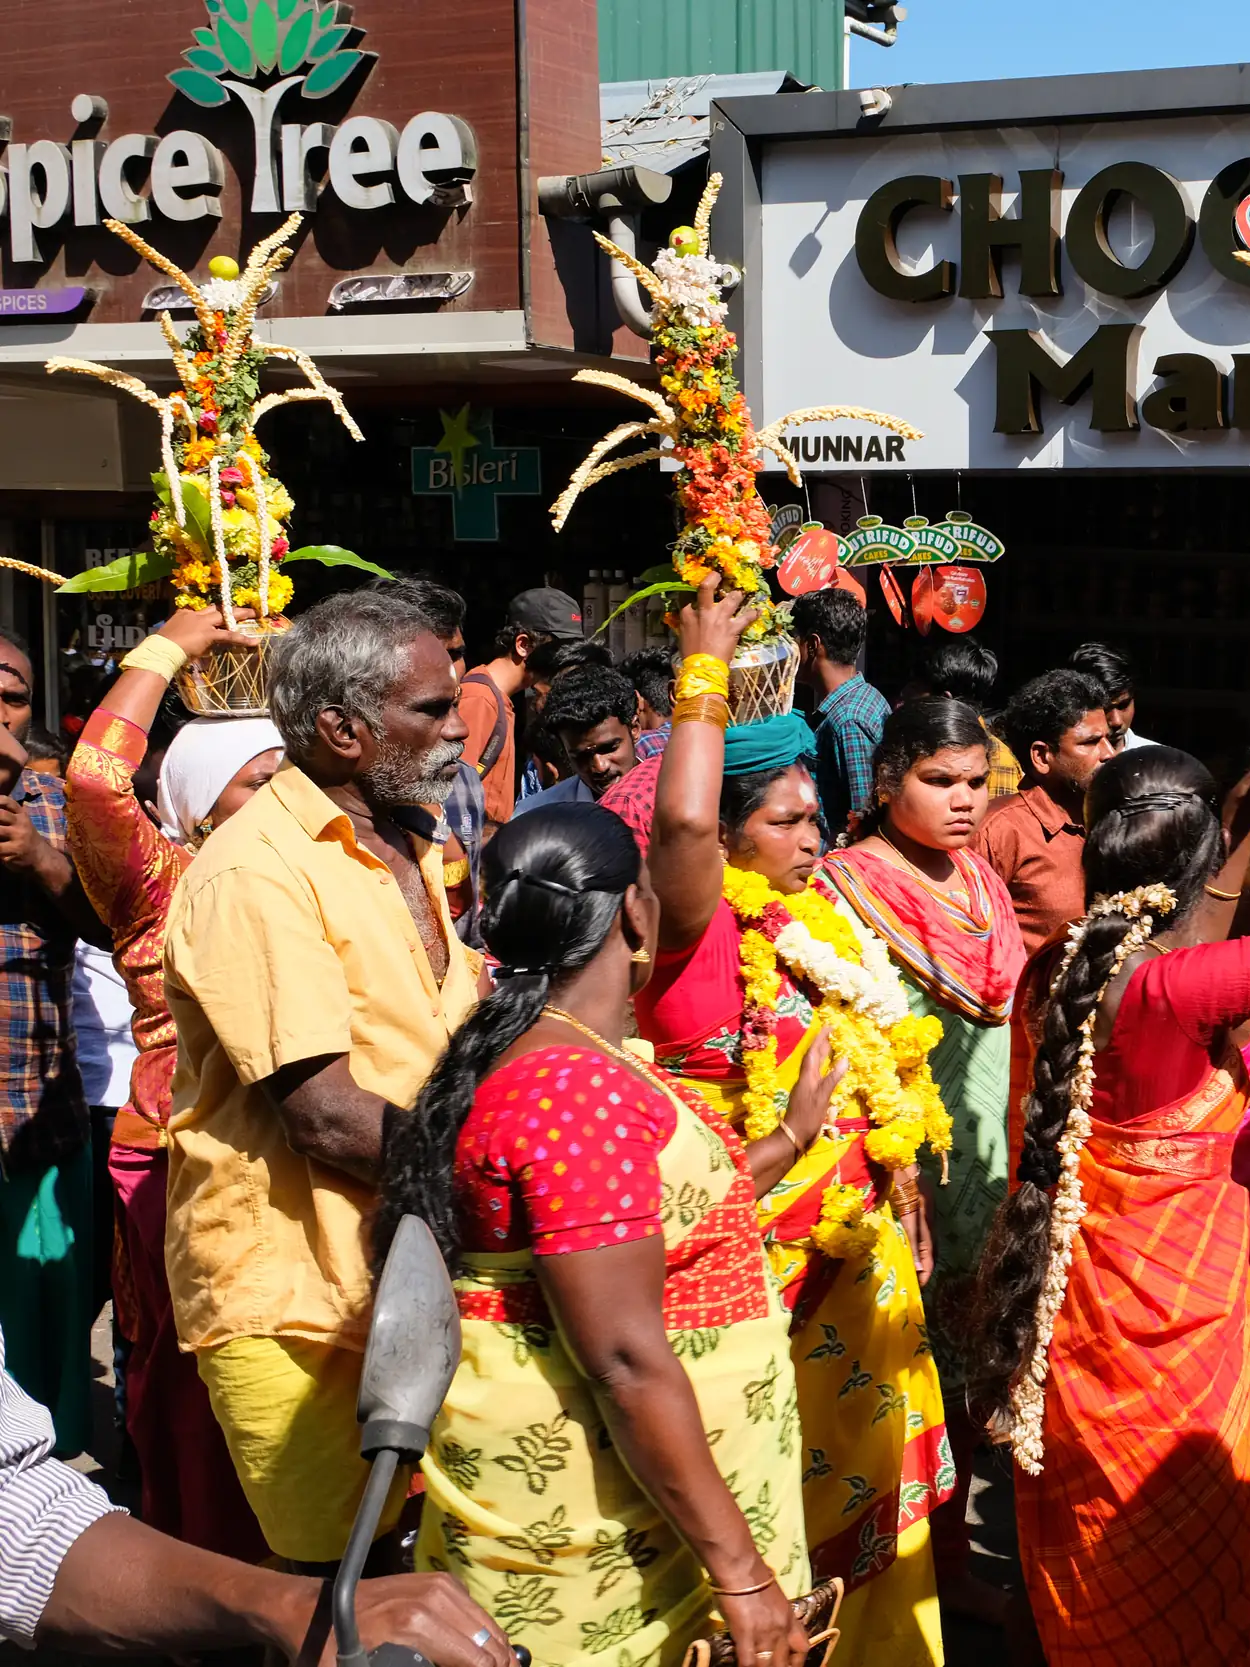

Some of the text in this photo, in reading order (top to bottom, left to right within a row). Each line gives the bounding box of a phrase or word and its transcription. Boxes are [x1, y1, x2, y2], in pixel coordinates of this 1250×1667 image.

[0, 78, 478, 263] pice Tree
[0, 294, 47, 311] PICES
[429, 452, 518, 489] Bisleri
[850, 528, 910, 552] UTRIFUD
[913, 531, 954, 554] RIFUD
[942, 525, 997, 554] TRIFUD
[910, 552, 932, 561] AKES
